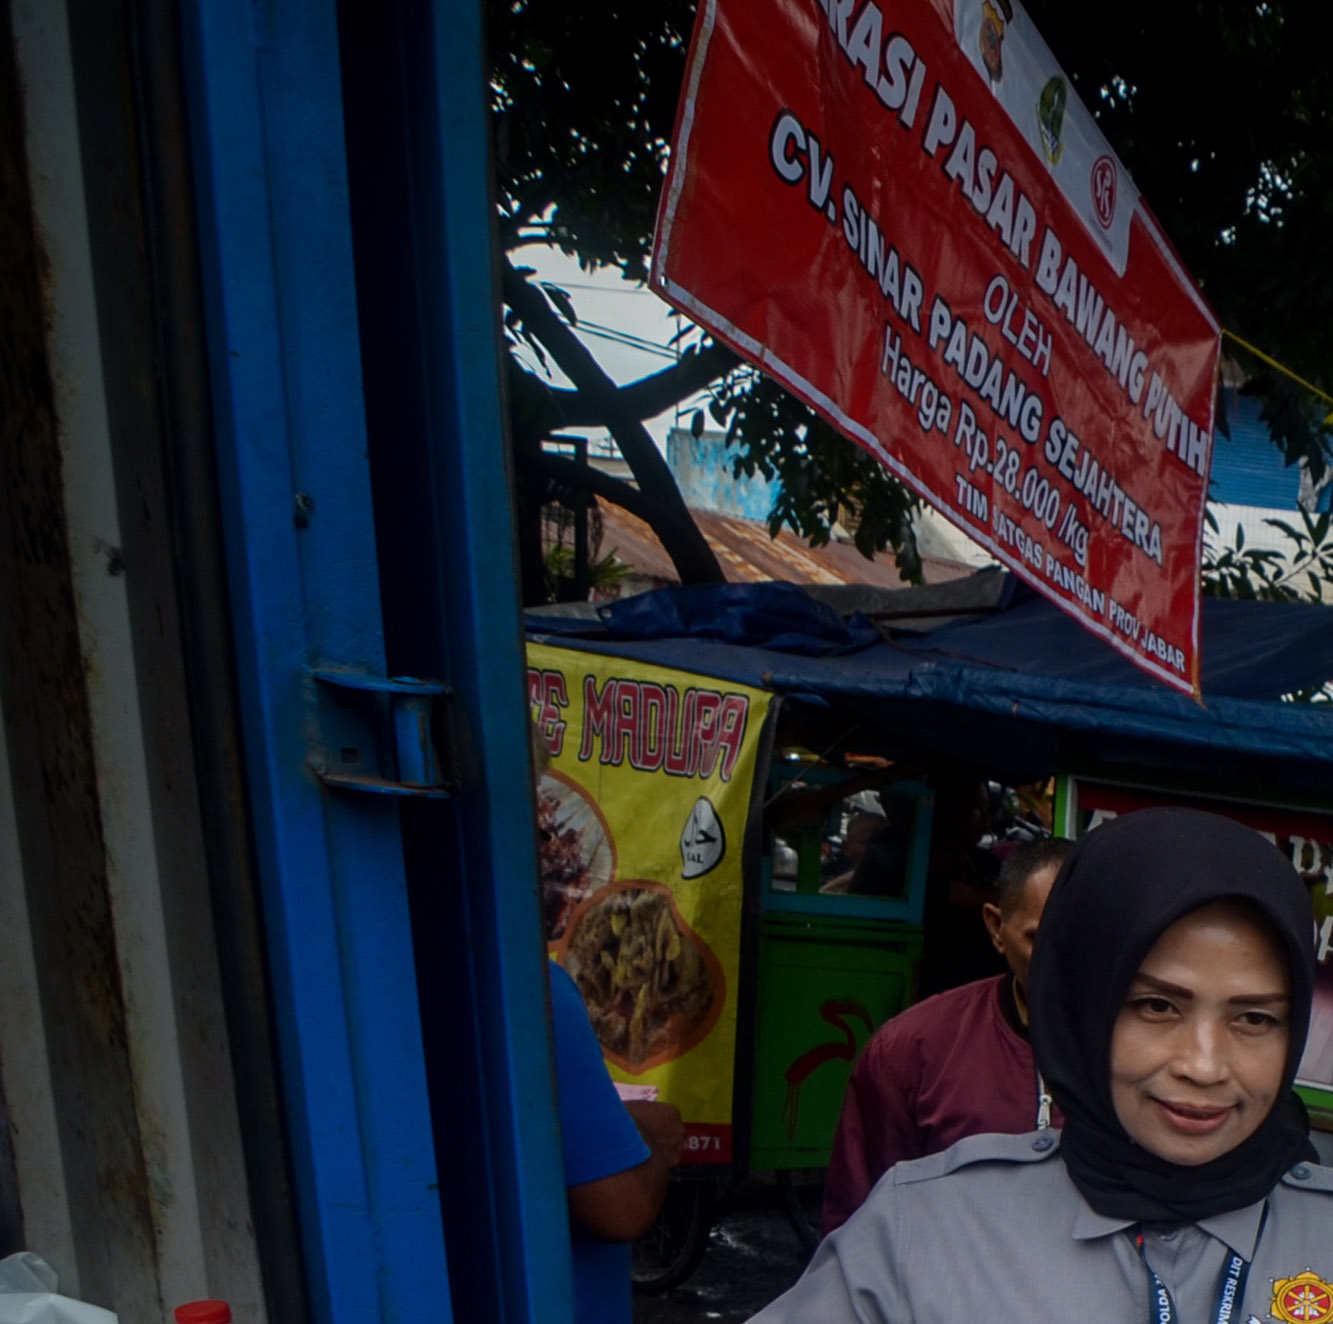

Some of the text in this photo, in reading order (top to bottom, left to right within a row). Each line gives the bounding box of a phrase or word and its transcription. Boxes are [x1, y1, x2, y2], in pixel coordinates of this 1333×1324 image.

[771, 113, 1163, 566] CV. SINAR PADANG SEJAHTERA
[922, 84, 1037, 269] PASAR
[1034, 226, 1149, 406] BAWANG
[1143, 371, 1209, 477] PUTIH
[983, 274, 1053, 377] OLEH
[881, 322, 952, 434] Harga
[955, 474, 1186, 673] TIM SATGAS PANGAN PROV JABAR
[579, 674, 749, 782] MADURA
